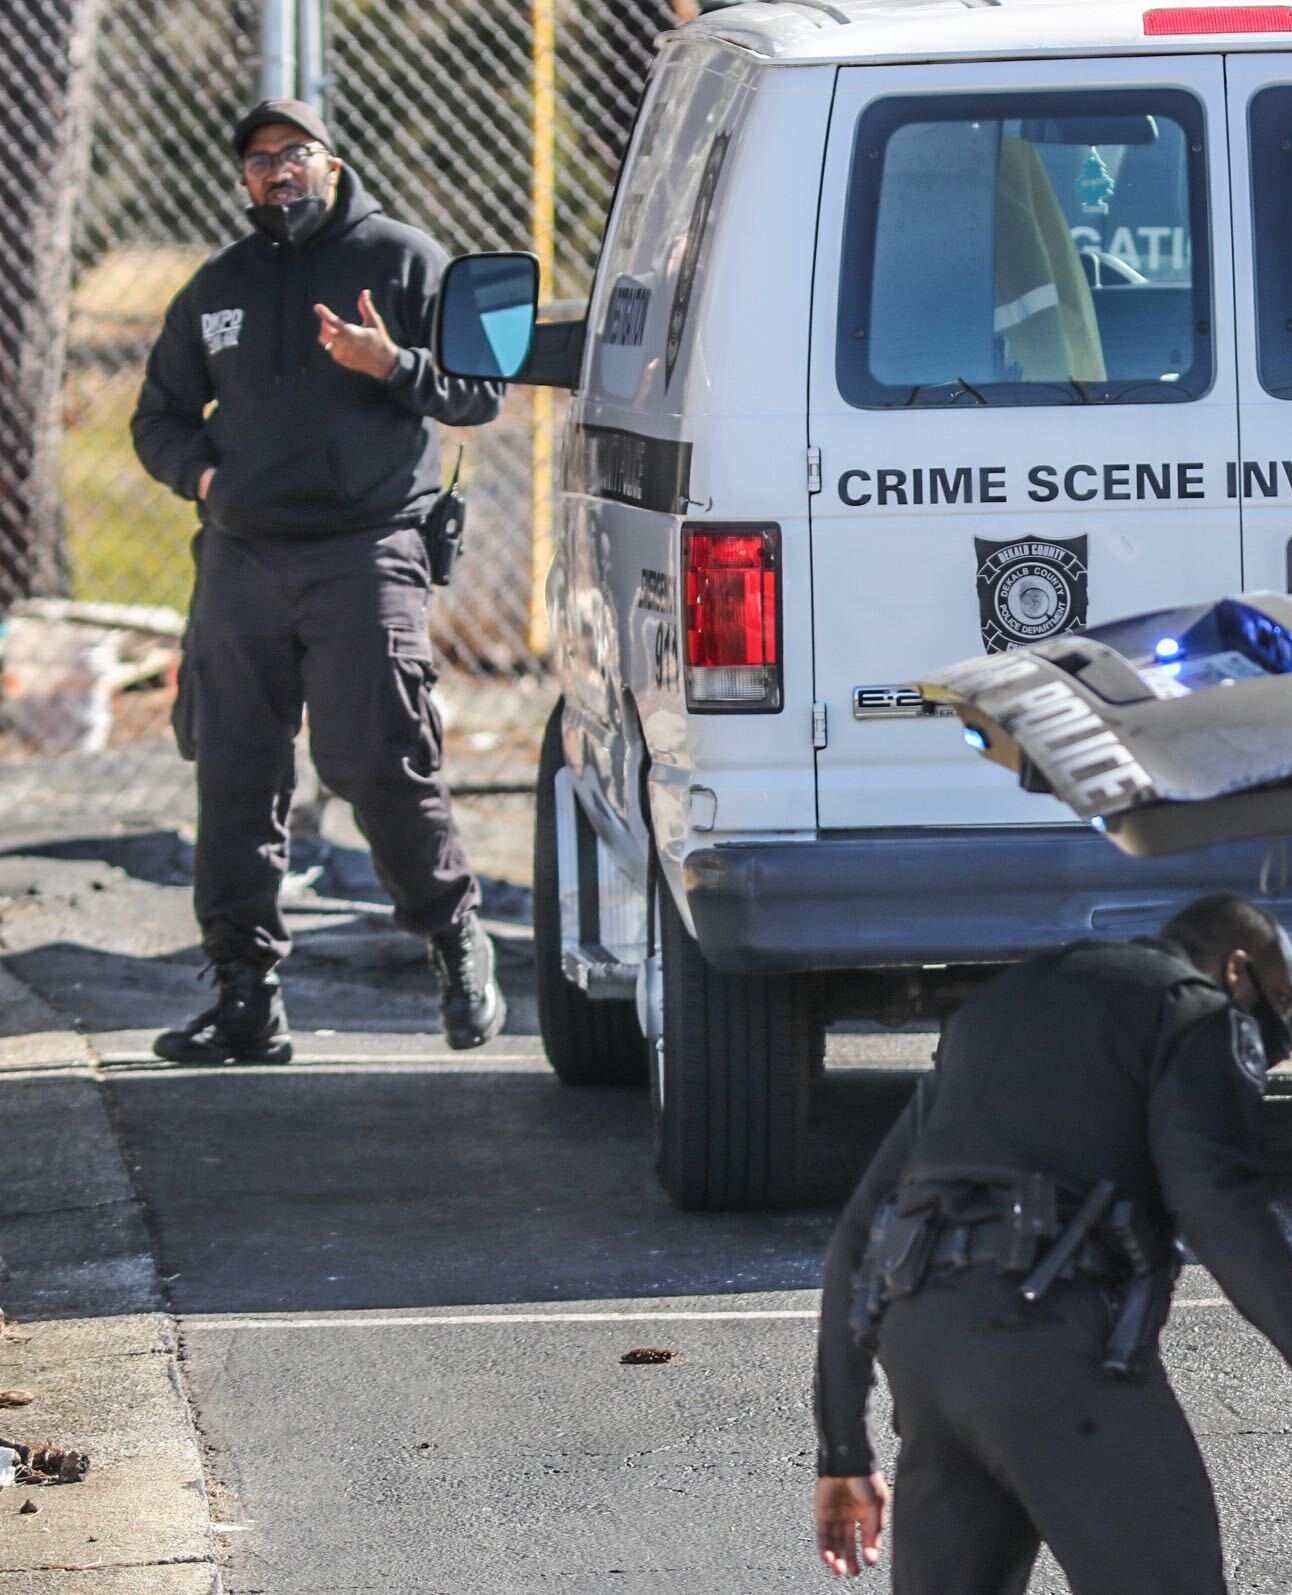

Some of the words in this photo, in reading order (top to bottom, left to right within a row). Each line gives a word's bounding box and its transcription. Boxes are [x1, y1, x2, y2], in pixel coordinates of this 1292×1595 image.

[837, 467, 1007, 506] CRIME
[1028, 463, 1204, 502] SCENE
[998, 544, 1030, 563] DEKALB
[1032, 544, 1066, 561] COUNTY
[1000, 567, 1030, 598] DEKALB
[1034, 567, 1065, 596] COUNTY
[1000, 604, 1022, 631] POLICE
[1022, 601, 1066, 634] DEPARTMENT
[1005, 680, 1153, 806] POLICE
